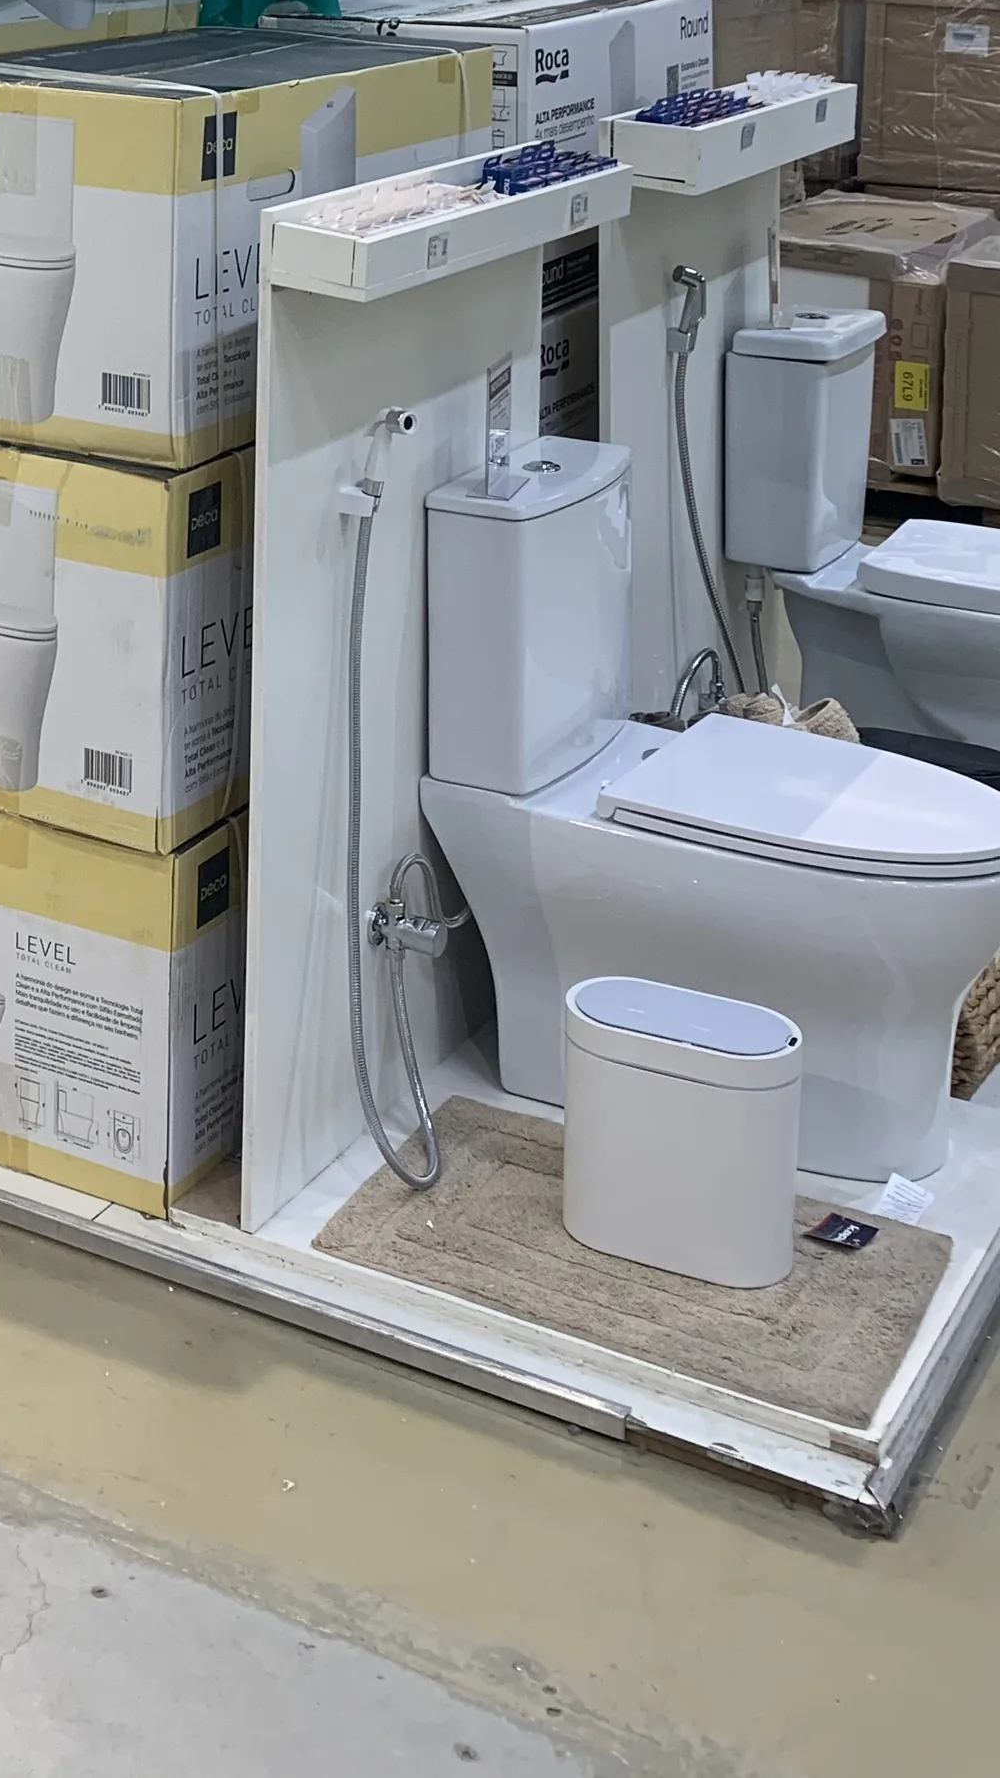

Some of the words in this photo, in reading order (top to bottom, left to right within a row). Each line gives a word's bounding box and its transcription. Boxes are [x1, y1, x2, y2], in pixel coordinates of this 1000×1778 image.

[680, 11, 709, 40] Round
[535, 48, 570, 73] Roca
[535, 111, 549, 126] ALTA
[550, 98, 595, 122] PERFORMANCE
[902, 371, 914, 402] 67L9
[182, 674, 222, 704] TOTAL
[15, 932, 76, 965] LEVEL
[16, 952, 40, 965] TOTAL
[44, 961, 72, 974] CLEAN
[193, 1032, 230, 1071] TOTAL
